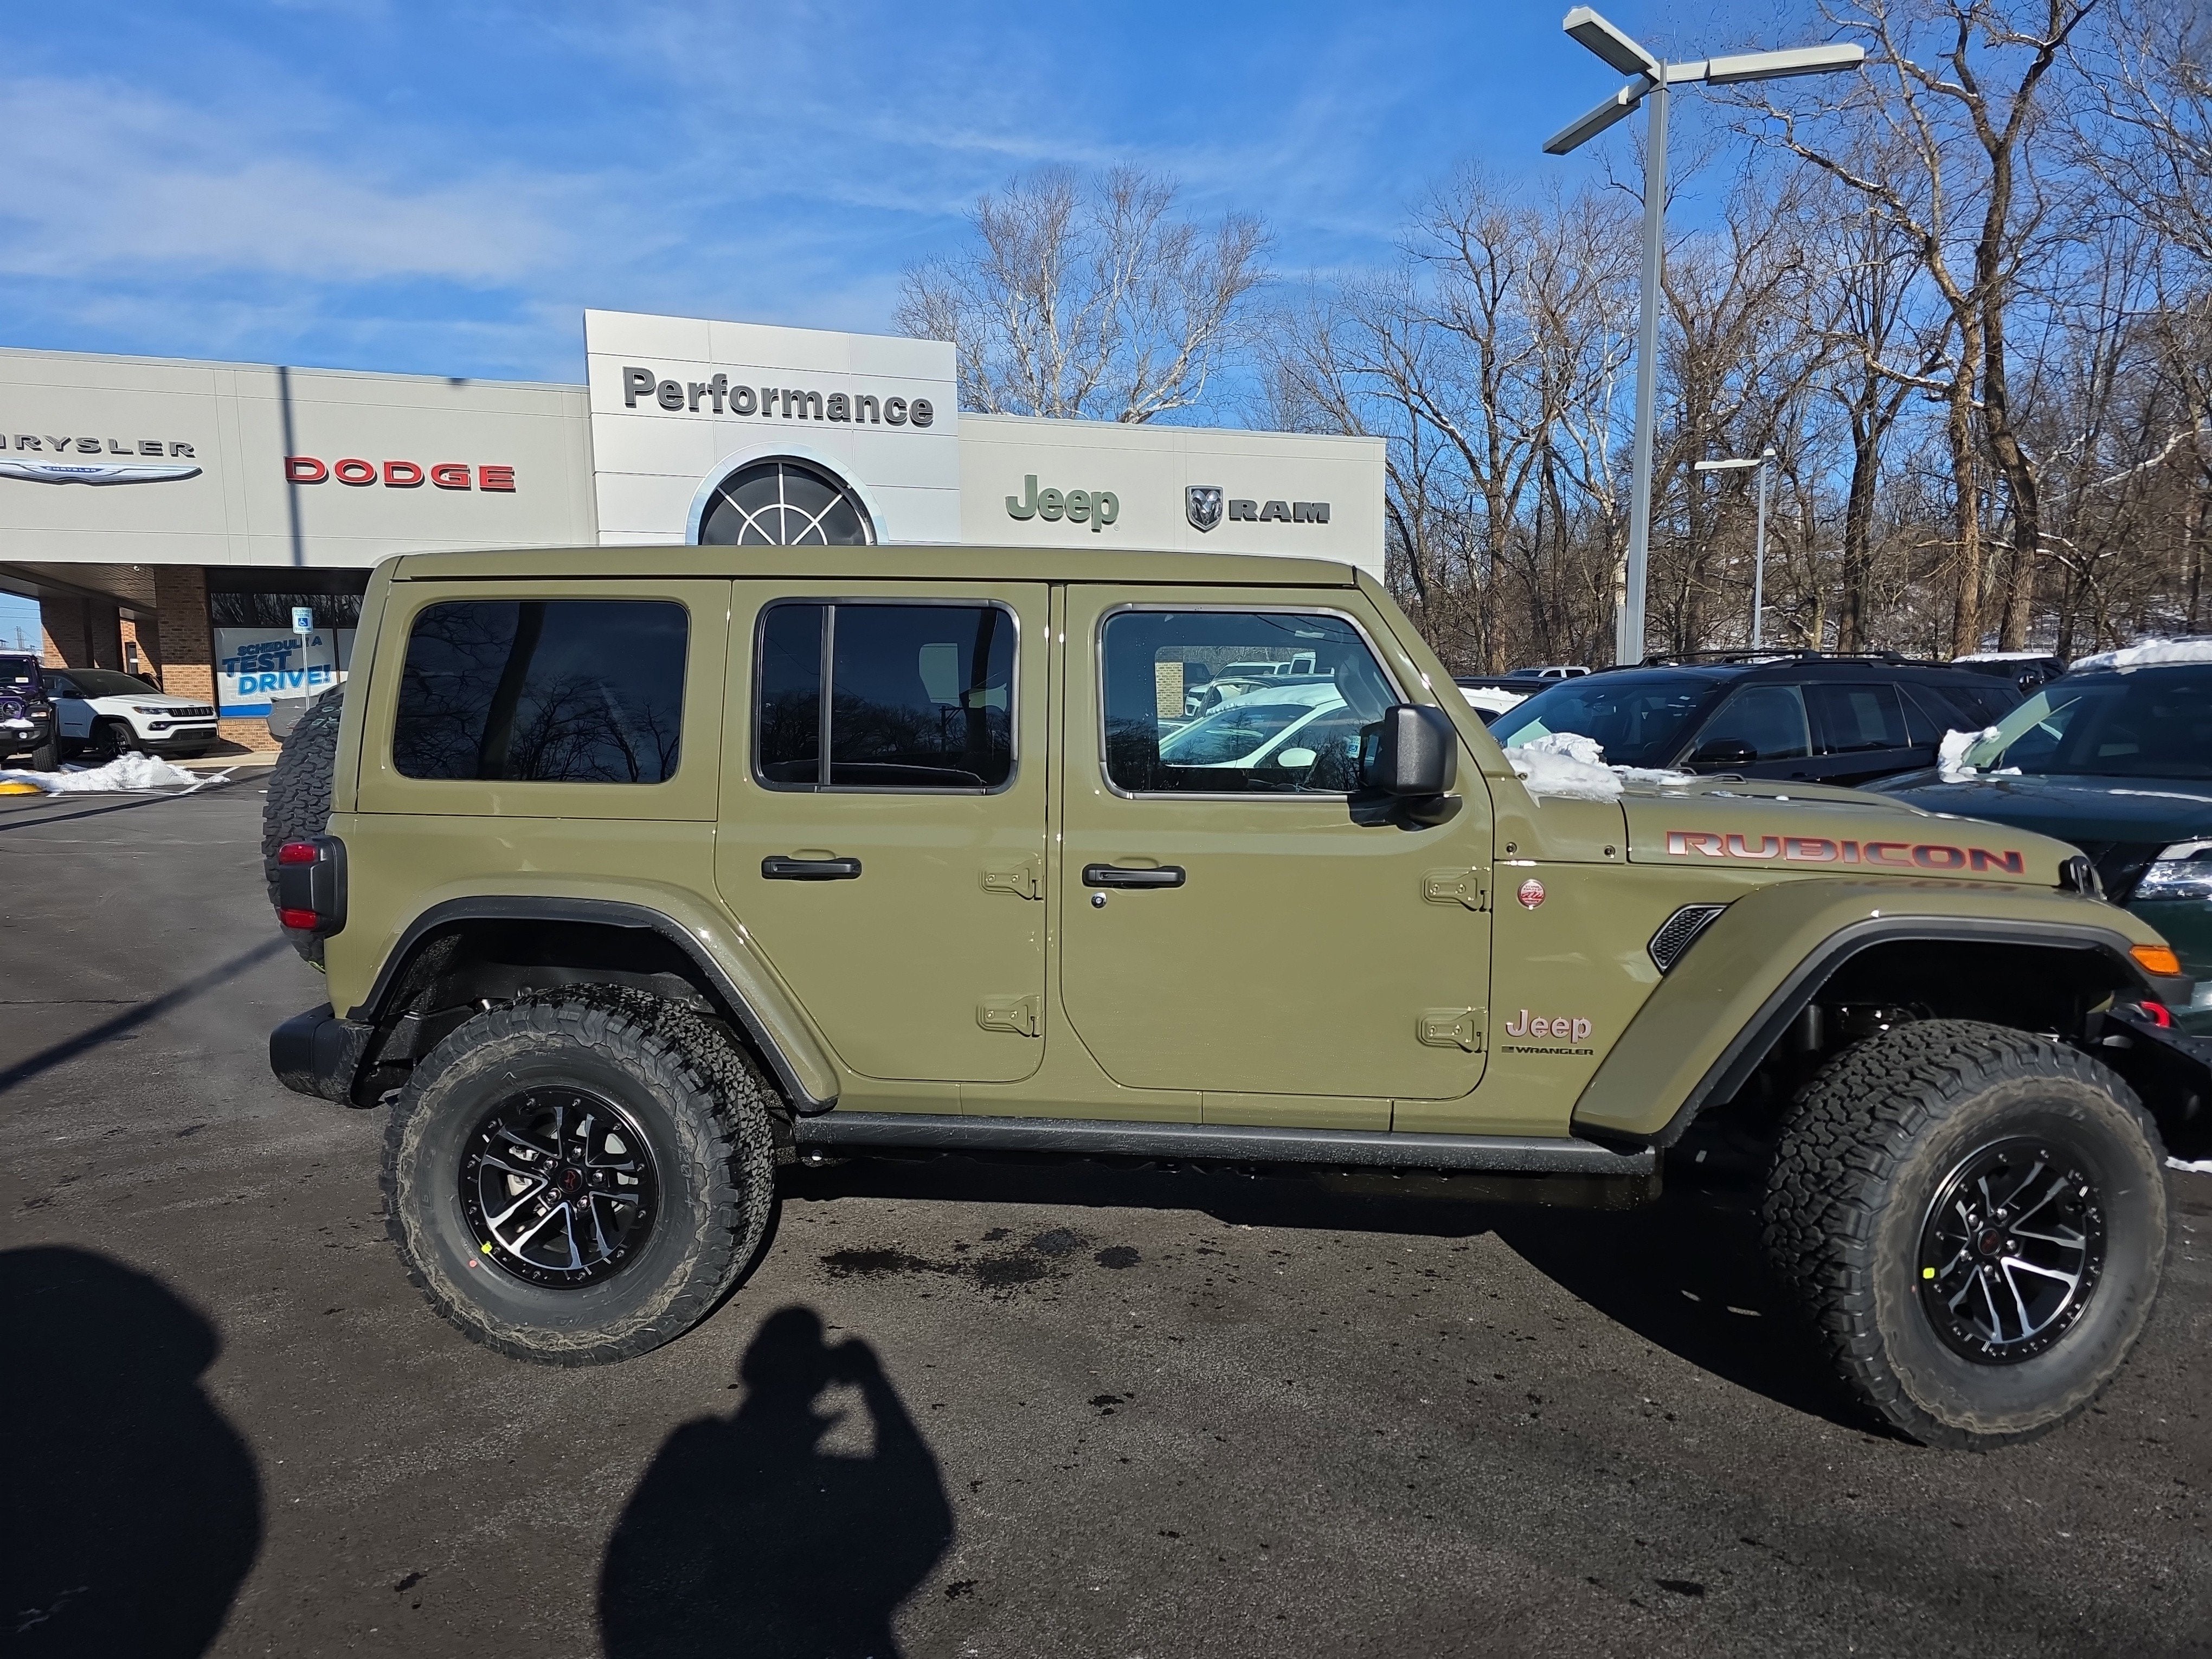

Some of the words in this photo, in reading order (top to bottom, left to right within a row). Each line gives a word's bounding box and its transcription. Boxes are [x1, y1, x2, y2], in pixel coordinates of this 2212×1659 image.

[622, 365, 936, 428] Performance
[0, 434, 197, 458] RYSLER
[283, 455, 517, 493] DODGE
[1005, 474, 1120, 533] Jeep
[1229, 499, 1330, 524] RAM
[311, 635, 323, 646] A
[222, 650, 292, 677] TEST
[237, 664, 331, 696] DRIVE!
[1667, 831, 2024, 874] RUBICON
[1506, 1009, 1592, 1044] Jeep
[1516, 1046, 1594, 1056] WRANGLER
